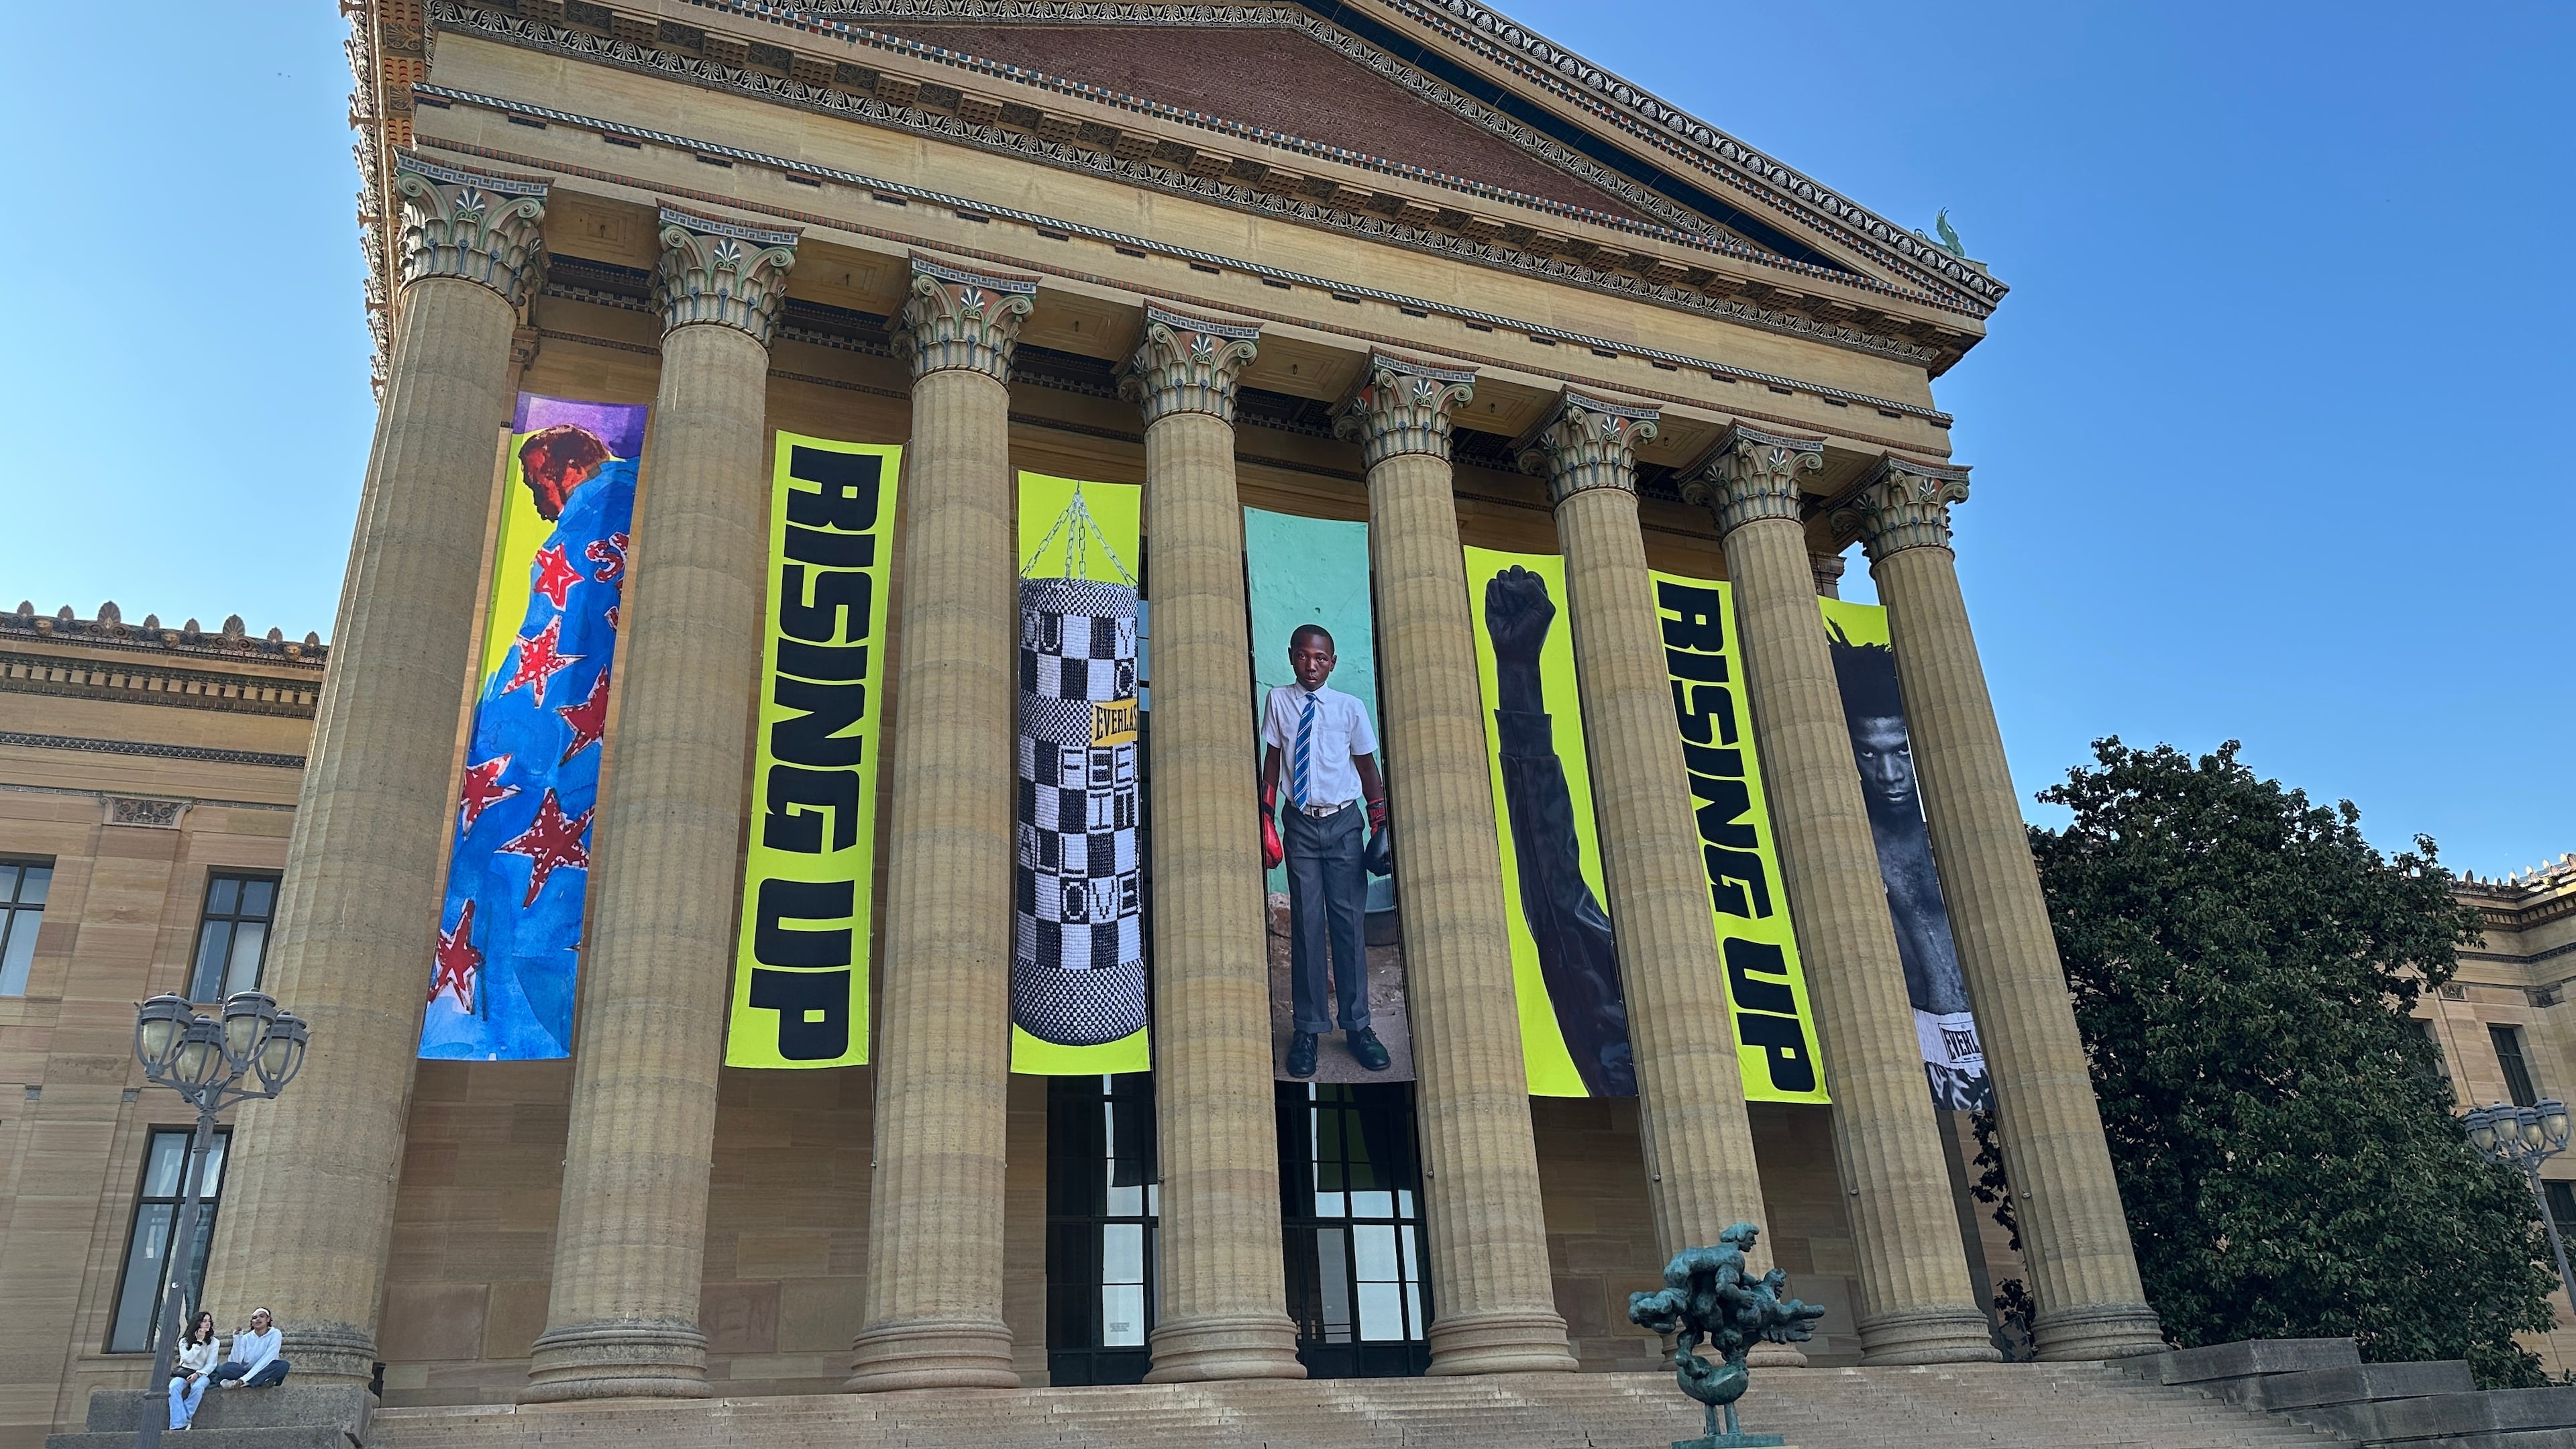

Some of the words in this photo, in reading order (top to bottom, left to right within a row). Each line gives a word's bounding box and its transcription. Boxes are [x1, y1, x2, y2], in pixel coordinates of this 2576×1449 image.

[763, 444, 883, 854] RISING
[1019, 826, 1085, 874] ALL
[1089, 788, 1134, 830] IT
[1656, 580, 1774, 919] RISING
[1723, 936, 1815, 1091] UP
[749, 878, 854, 1060] UP
[1941, 1027, 1982, 1060] EVERL
